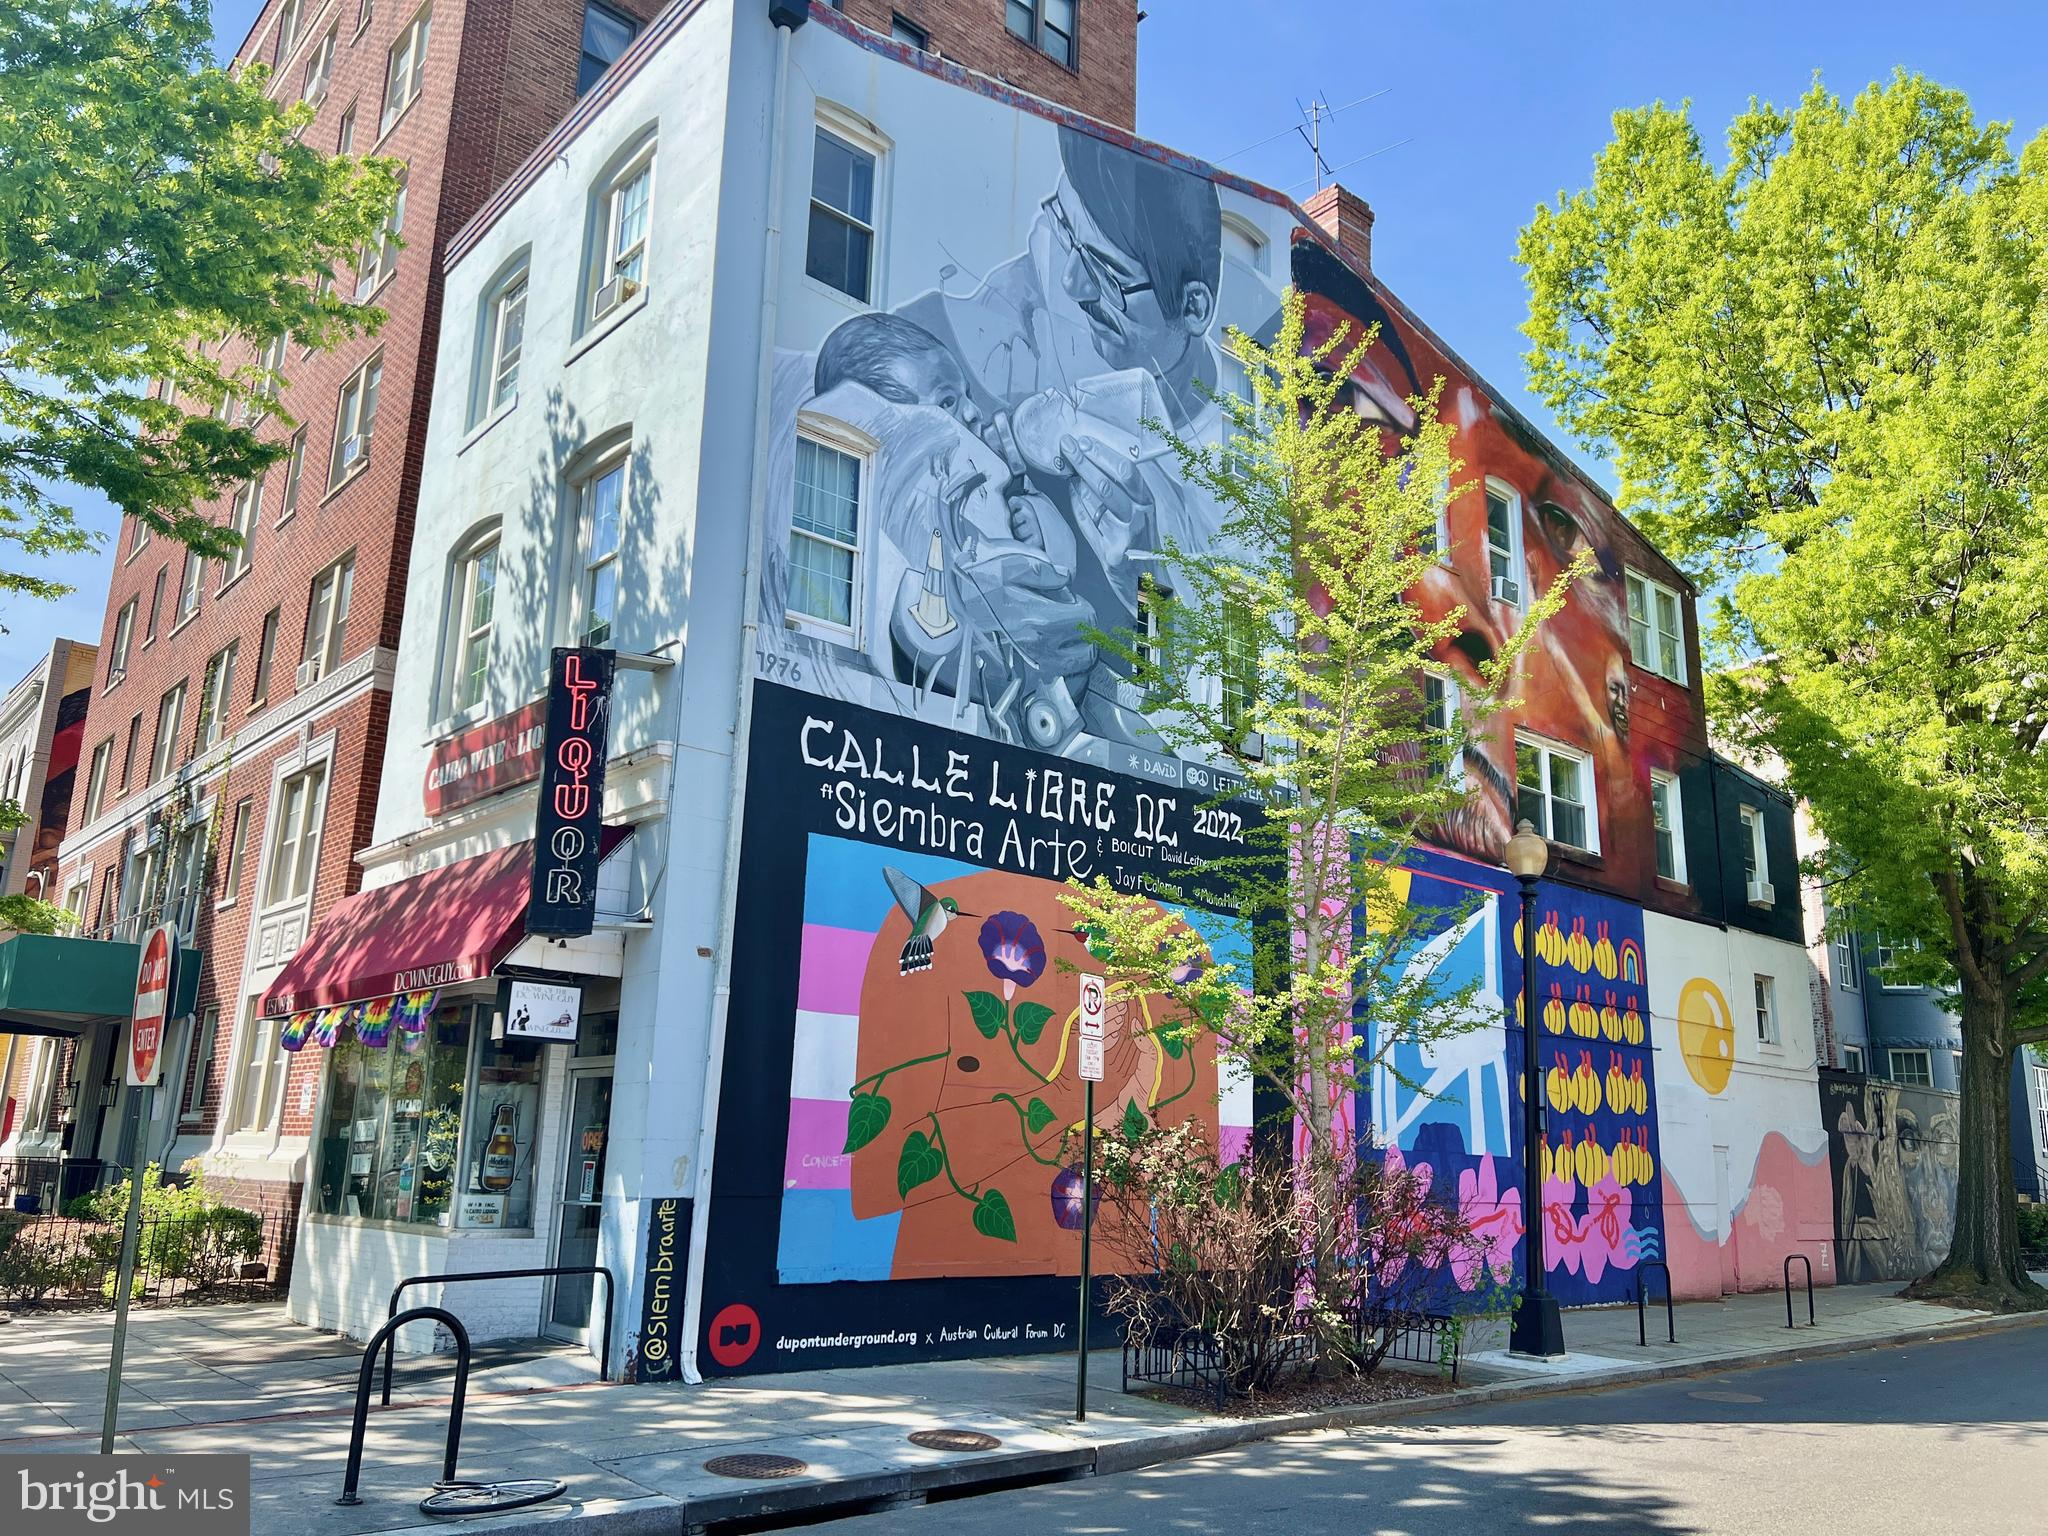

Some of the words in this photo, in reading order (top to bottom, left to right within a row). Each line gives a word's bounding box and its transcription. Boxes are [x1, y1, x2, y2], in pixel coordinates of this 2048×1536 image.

[756, 651, 801, 682] 1976
[428, 756, 468, 791] CAIRO
[470, 740, 506, 774] WINE
[546, 655, 597, 904] LIQUOR
[801, 716, 974, 802] CALLE
[1134, 794, 1178, 847] DC
[1193, 806, 1244, 844] 2022
[835, 781, 983, 860] Siembra
[998, 818, 1093, 879] Arte
[1111, 837, 1154, 858] BOICUT
[142, 962, 151, 985] DO
[153, 957, 166, 982] NOT
[533, 992, 555, 1001] WINE
[136, 1027, 156, 1051] ENTER
[776, 1329, 917, 1352] dupontunderground.org
[940, 1324, 977, 1342] Austrian
[984, 1324, 1018, 1341] Cultural
[1026, 1325, 1048, 1339] Forum
[1053, 1323, 1066, 1339] DC
